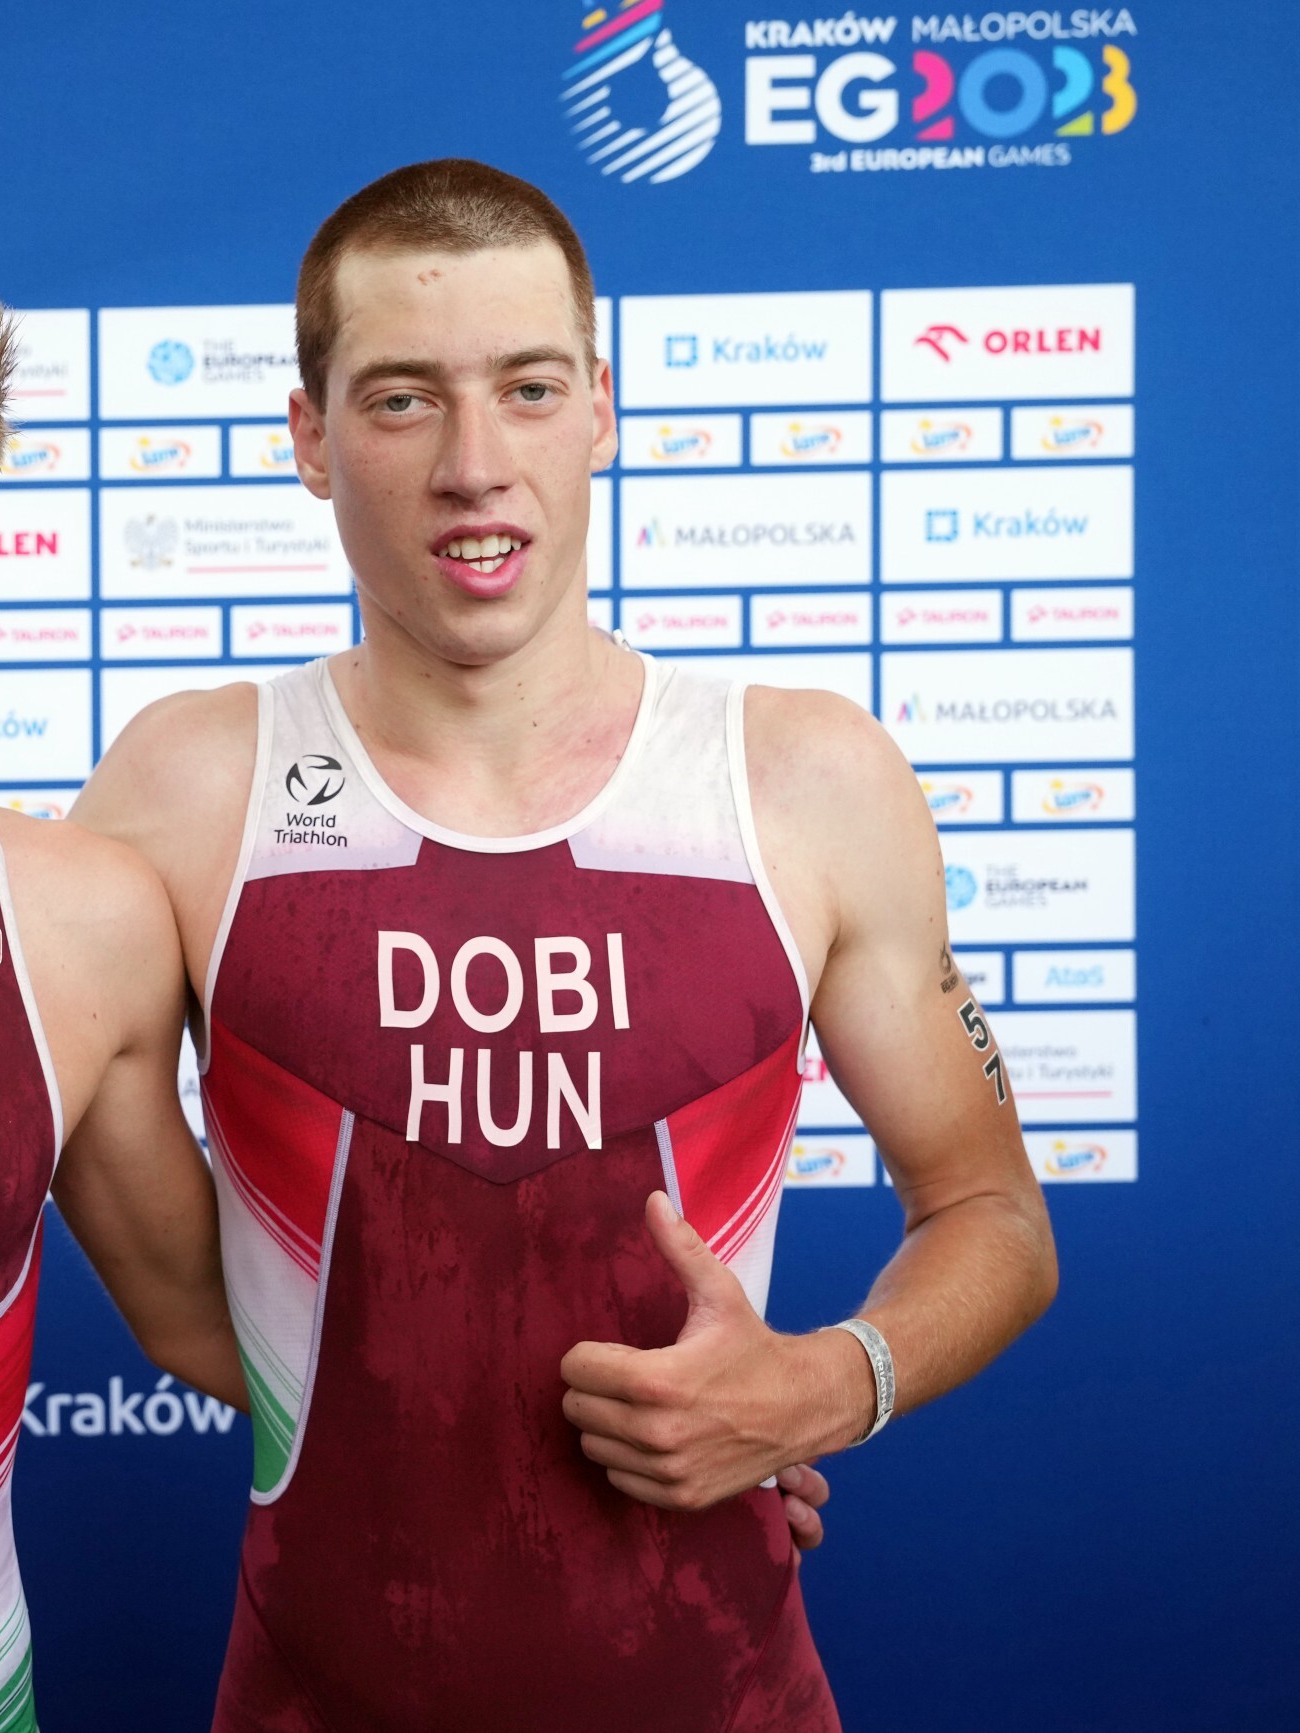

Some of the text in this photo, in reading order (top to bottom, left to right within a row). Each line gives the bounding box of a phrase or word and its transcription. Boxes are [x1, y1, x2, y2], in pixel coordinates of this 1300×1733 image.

[746, 9, 1137, 48] KRAKÓW MAŁOPOLSKA
[810, 143, 1070, 173] 3rd EUROPEAN GAMES
[712, 335, 827, 362] Kraków
[984, 328, 1101, 354] ORLEN
[203, 354, 297, 368] EUROPEA
[675, 522, 854, 547] MAŁOPOLSKA
[973, 509, 1088, 537] Kraków
[936, 698, 1118, 723] MAŁOPOLSKA
[286, 812, 336, 828] World
[274, 829, 348, 848] Triathlon
[377, 930, 630, 1033] DOBI
[406, 1044, 602, 1150] HUN
[21, 1376, 236, 1436] Kraków
